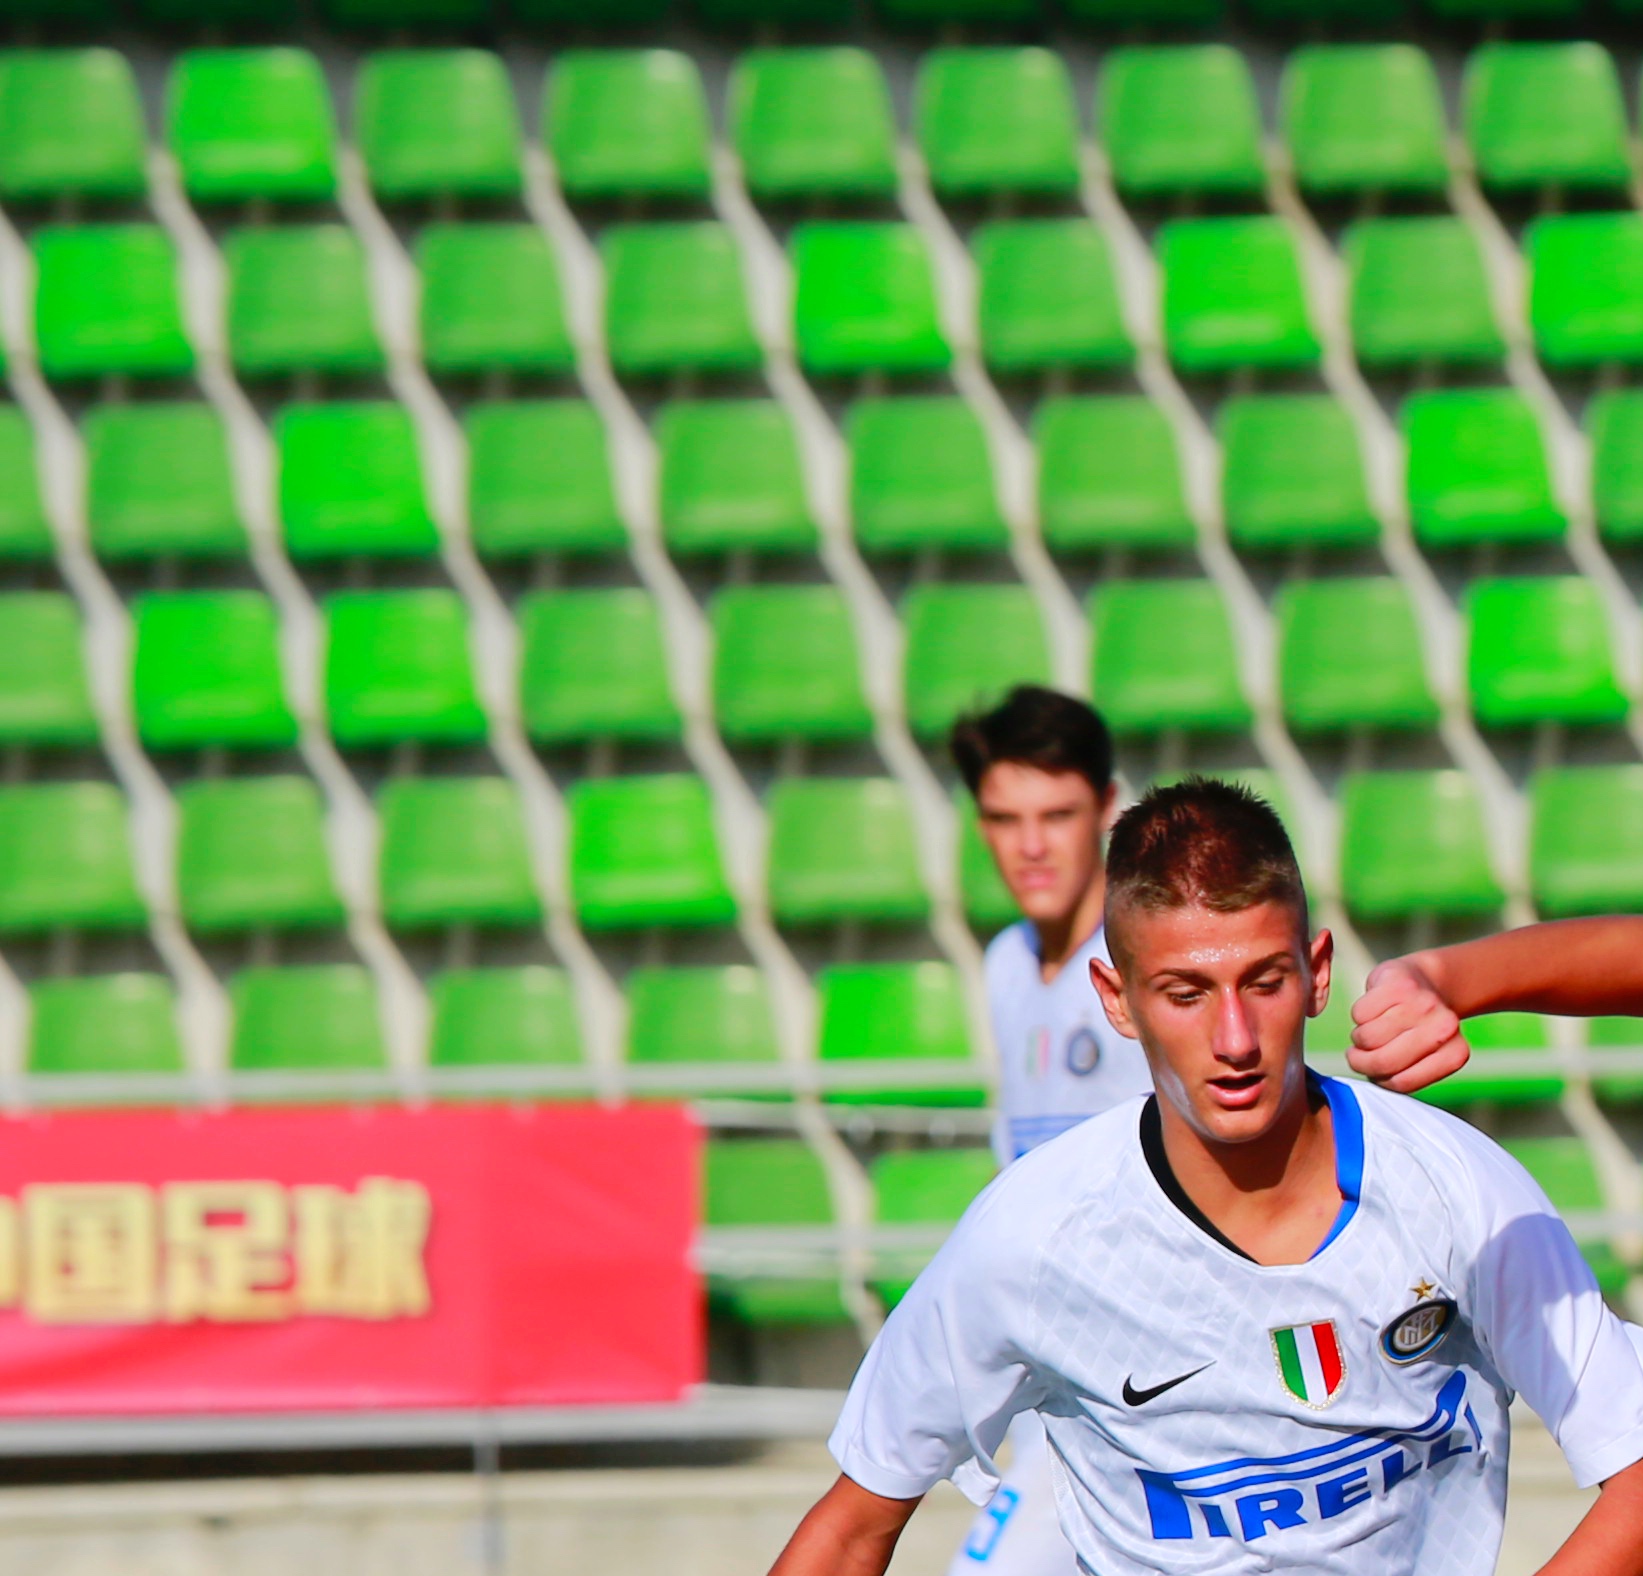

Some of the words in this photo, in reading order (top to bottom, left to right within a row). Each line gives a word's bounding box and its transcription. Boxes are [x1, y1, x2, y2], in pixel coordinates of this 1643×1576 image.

[0, 1177, 430, 1324] 国足球
[1135, 1370, 1483, 1542] PIRELLI
